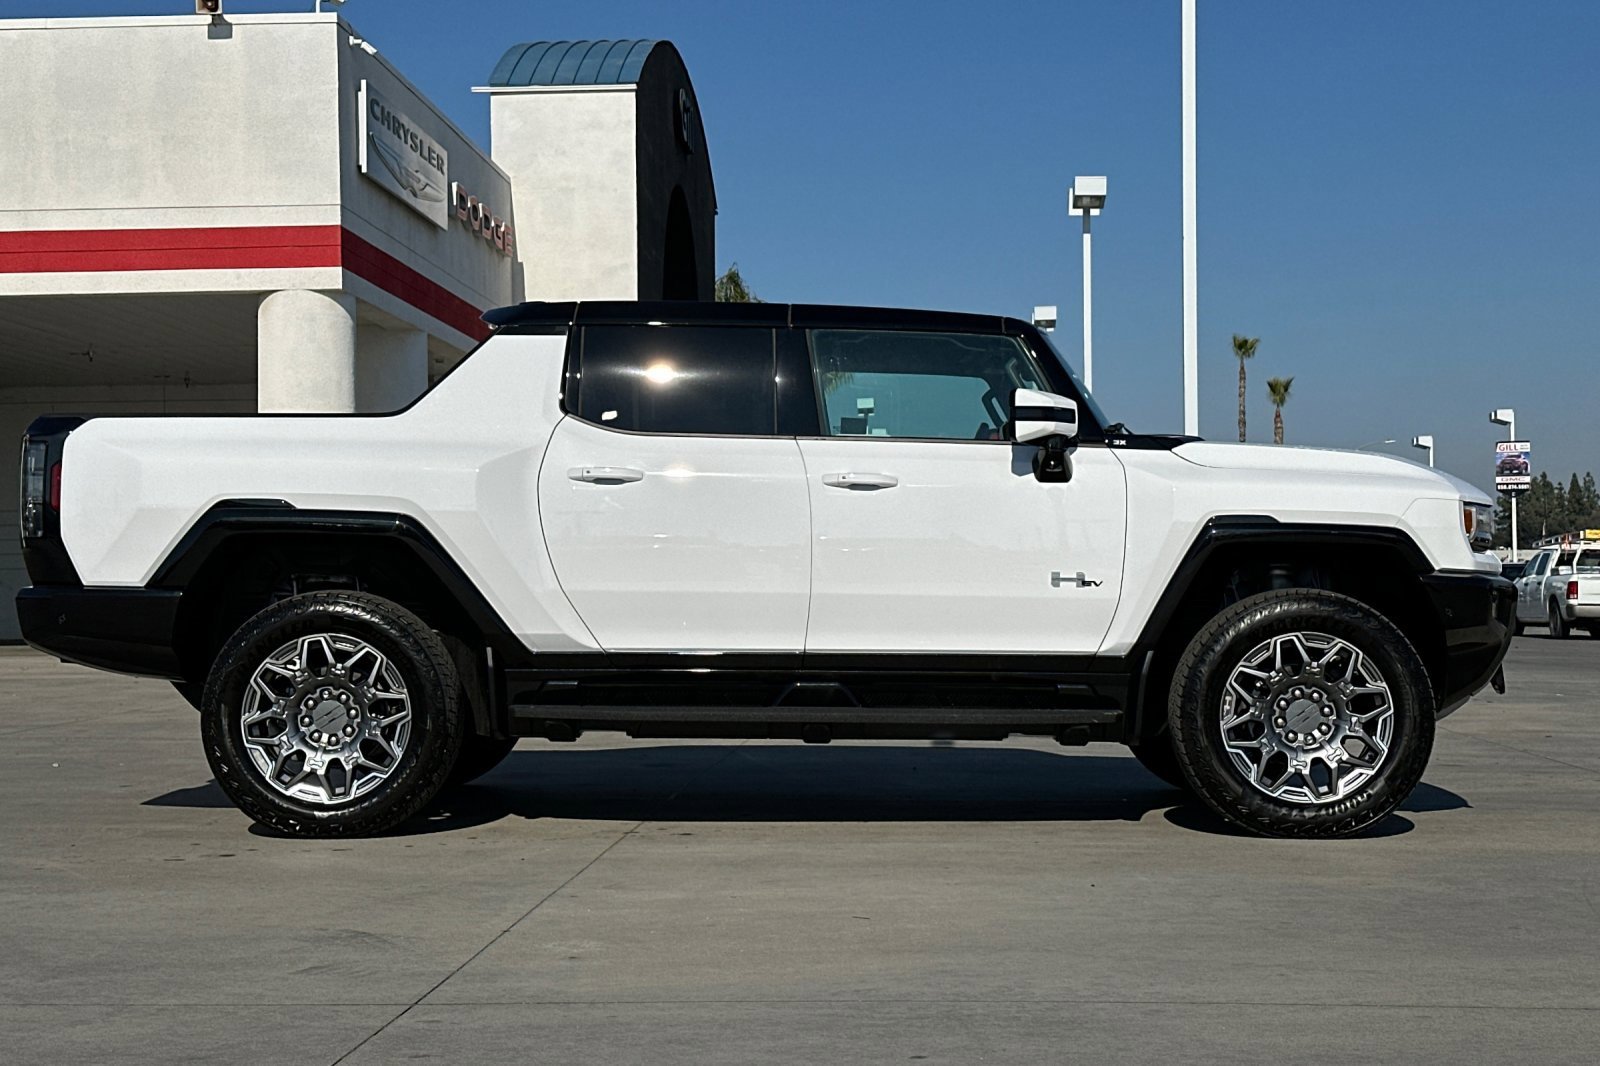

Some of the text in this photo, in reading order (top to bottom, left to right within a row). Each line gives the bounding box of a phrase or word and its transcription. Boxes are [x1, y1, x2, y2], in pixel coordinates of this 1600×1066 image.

[370, 98, 445, 176] CHRYSLER
[452, 181, 513, 257] DODGE
[1498, 443, 1519, 451] GILL
